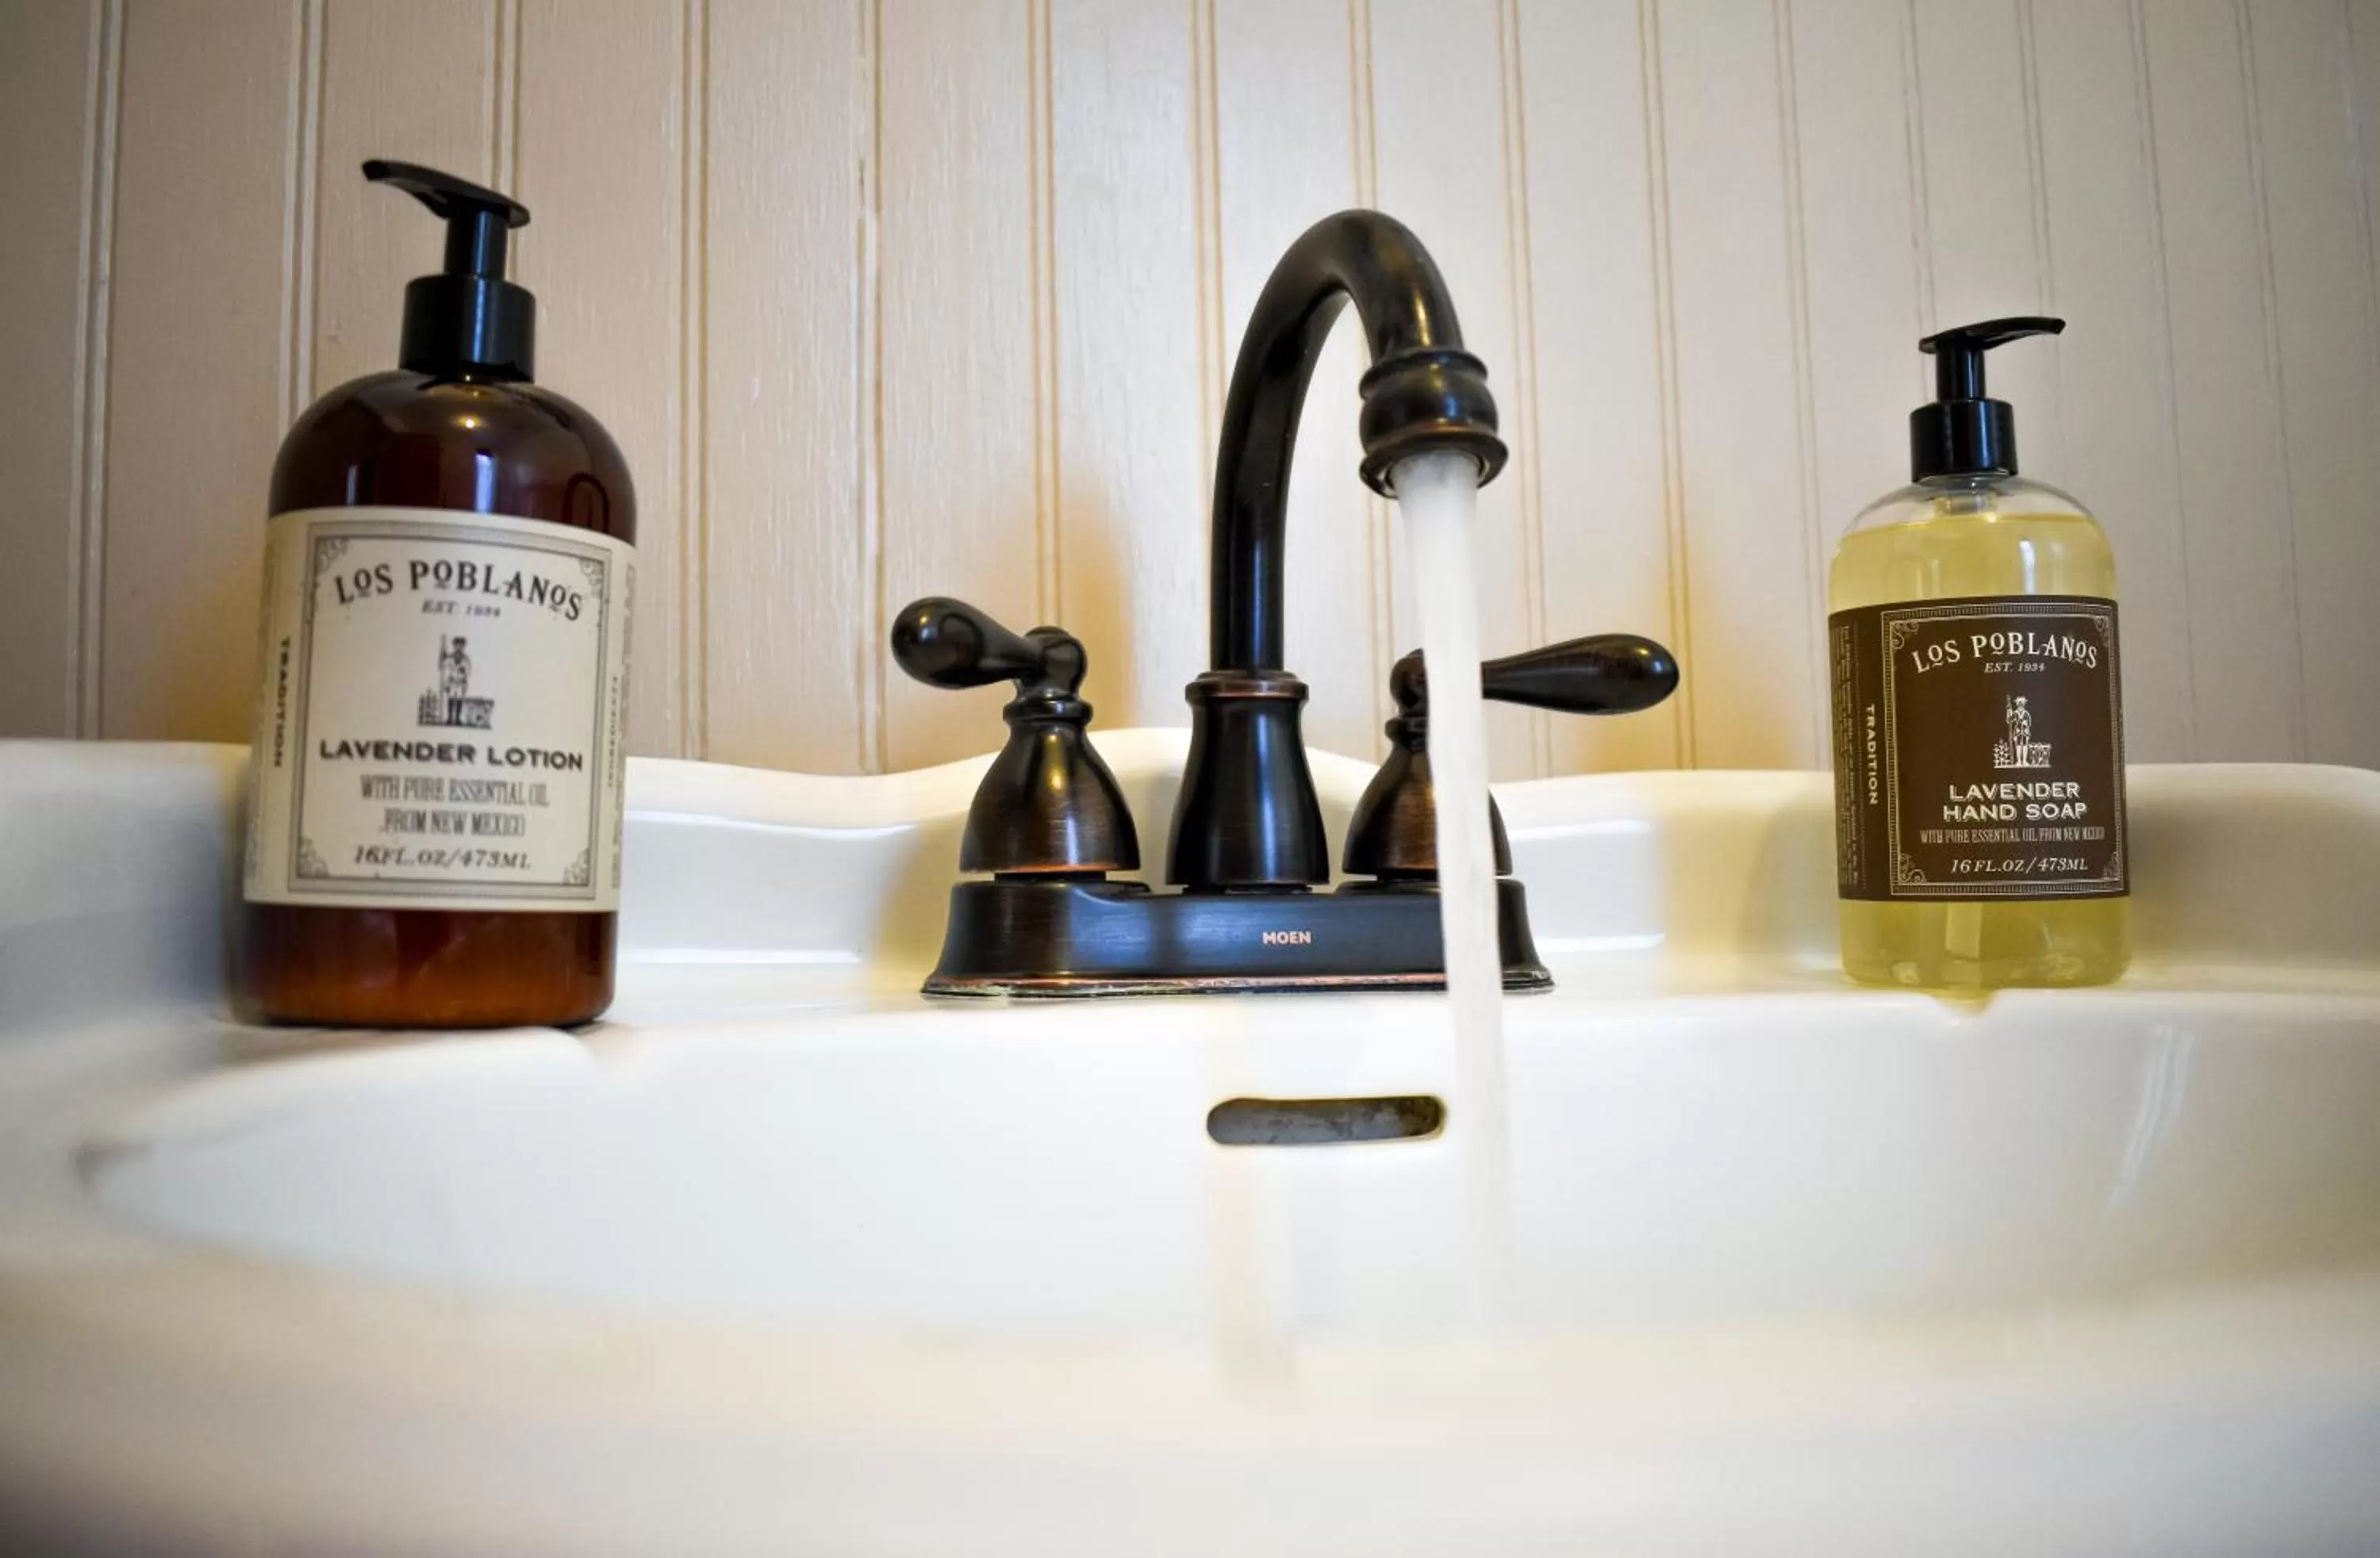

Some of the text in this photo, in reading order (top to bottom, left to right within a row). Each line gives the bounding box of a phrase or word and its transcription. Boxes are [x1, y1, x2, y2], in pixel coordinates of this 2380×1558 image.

[334, 559, 582, 621] LOS POBLANOS
[1912, 632, 2097, 673] LOS POBLANOS
[1984, 662, 2046, 673] EST. 1934
[319, 739, 583, 773] LAVENDER LOTION
[1866, 704, 1878, 804] TRADITION
[360, 774, 399, 800] WITH
[1949, 782, 2081, 801] LAVENDER
[431, 809, 466, 835] NEW
[1943, 802, 2088, 823] HAND SOAP
[1262, 931, 1311, 945] MOEN
